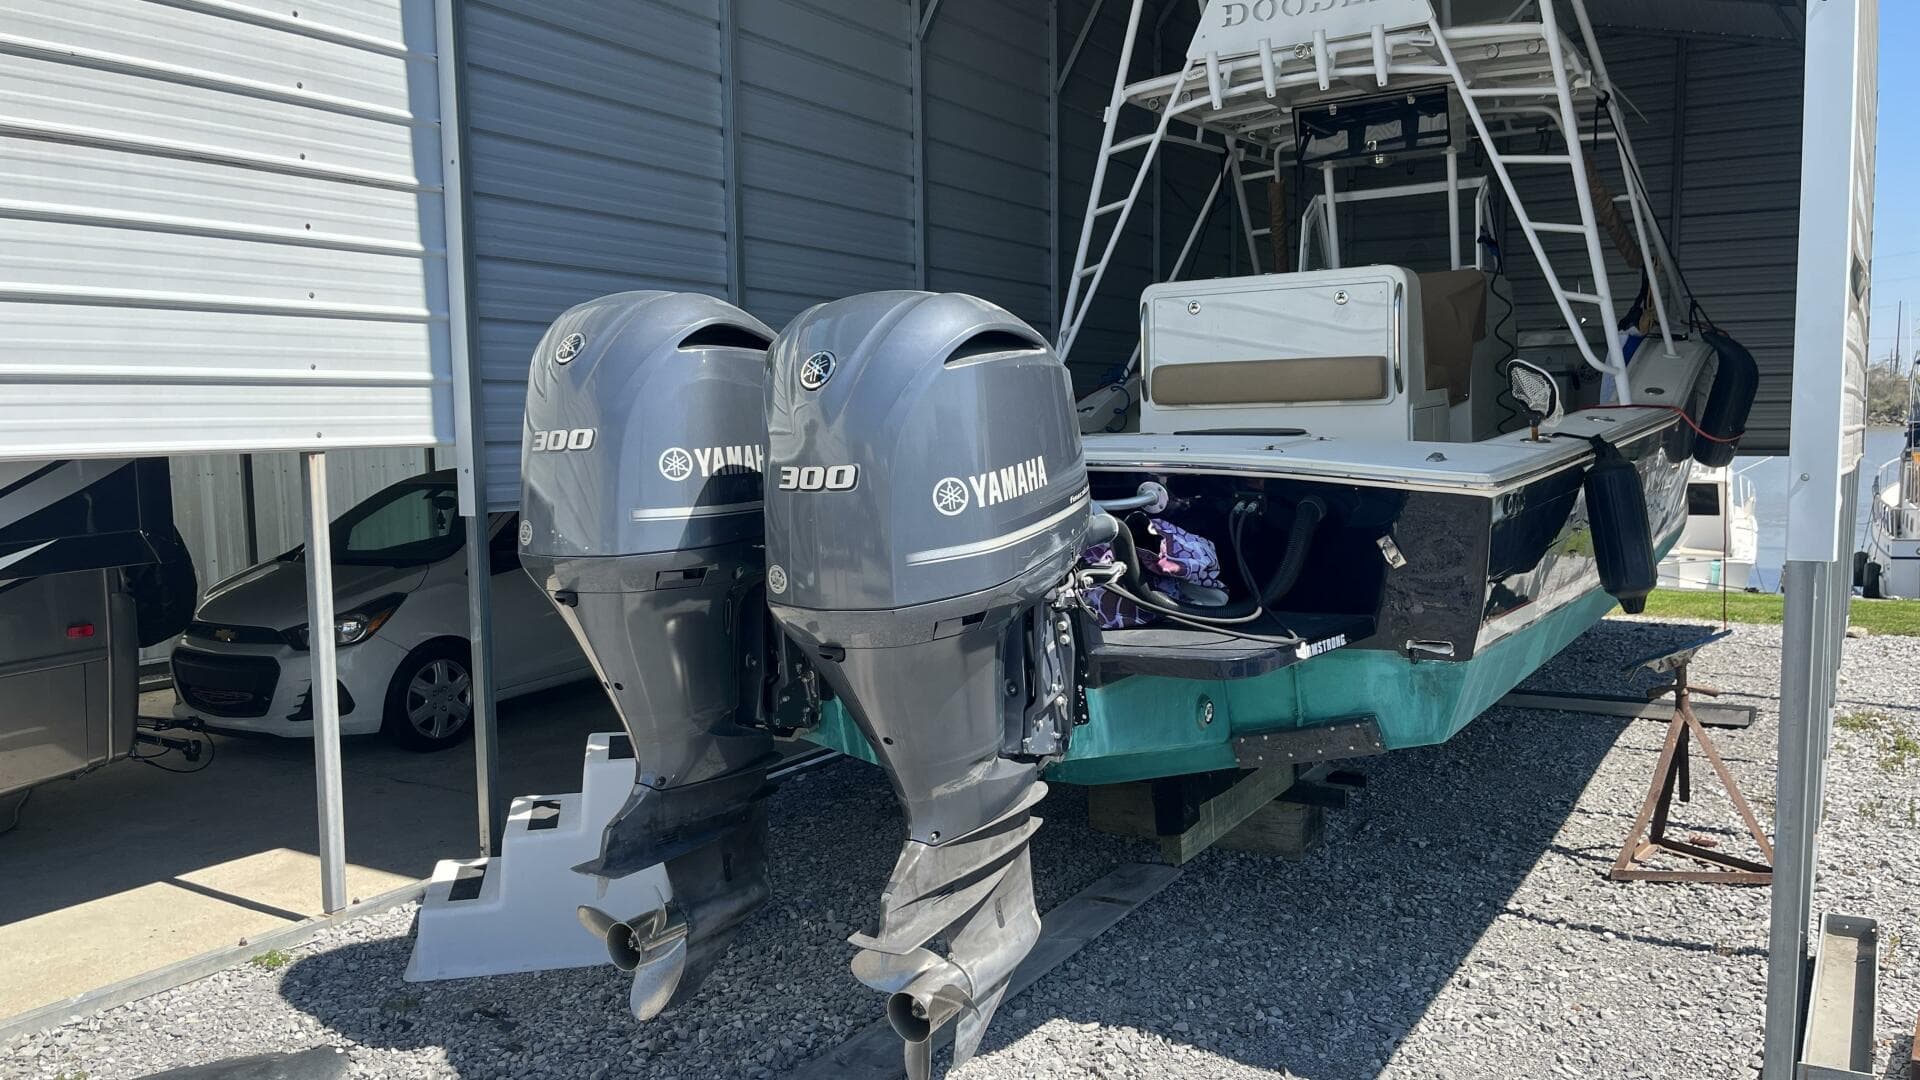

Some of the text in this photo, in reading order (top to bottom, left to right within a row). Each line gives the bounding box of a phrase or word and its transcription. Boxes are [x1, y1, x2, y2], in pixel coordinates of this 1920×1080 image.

[532, 428, 595, 452] 300
[779, 464, 857, 491] 300
[968, 455, 1048, 508] YAMAHA
